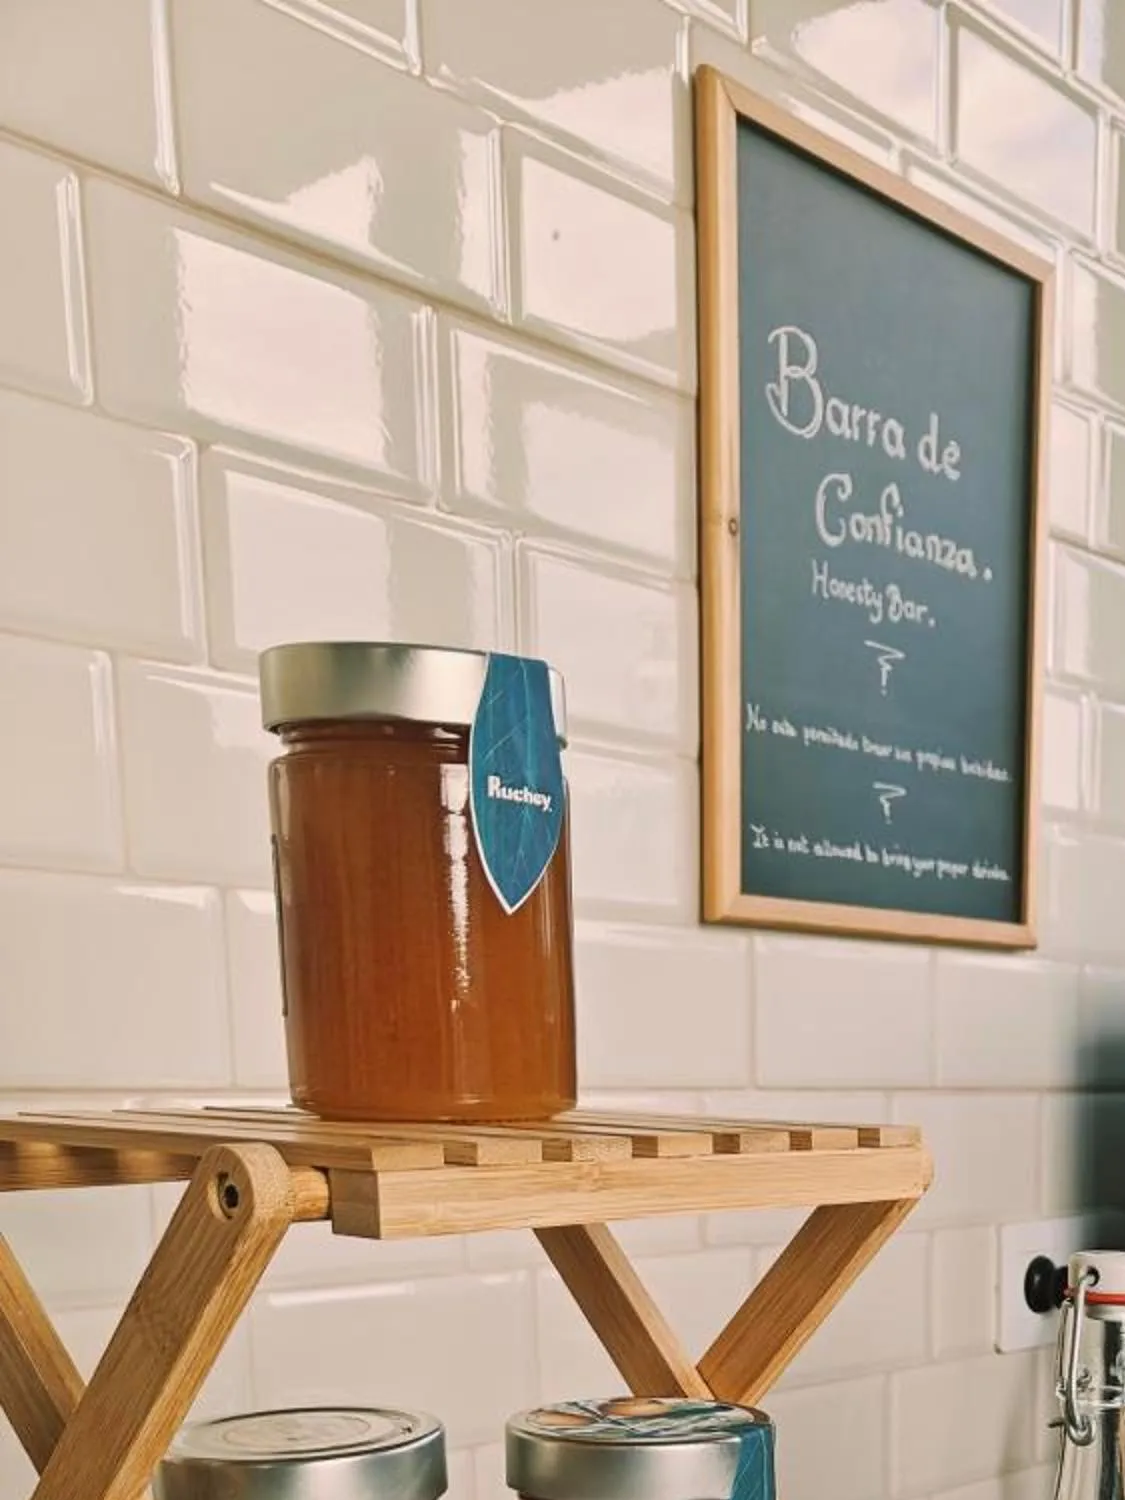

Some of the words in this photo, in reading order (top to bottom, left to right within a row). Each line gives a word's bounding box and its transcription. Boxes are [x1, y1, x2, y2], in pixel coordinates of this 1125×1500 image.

[765, 325, 906, 460] Barra
[918, 412, 961, 481] de
[815, 473, 993, 581] Confianza.
[811, 558, 883, 624] Honesty
[885, 582, 937, 628] Bar.
[745, 702, 767, 732] No
[749, 824, 769, 848] It
[772, 831, 785, 849] is
[787, 834, 810, 854] not
[881, 844, 911, 871] bring
